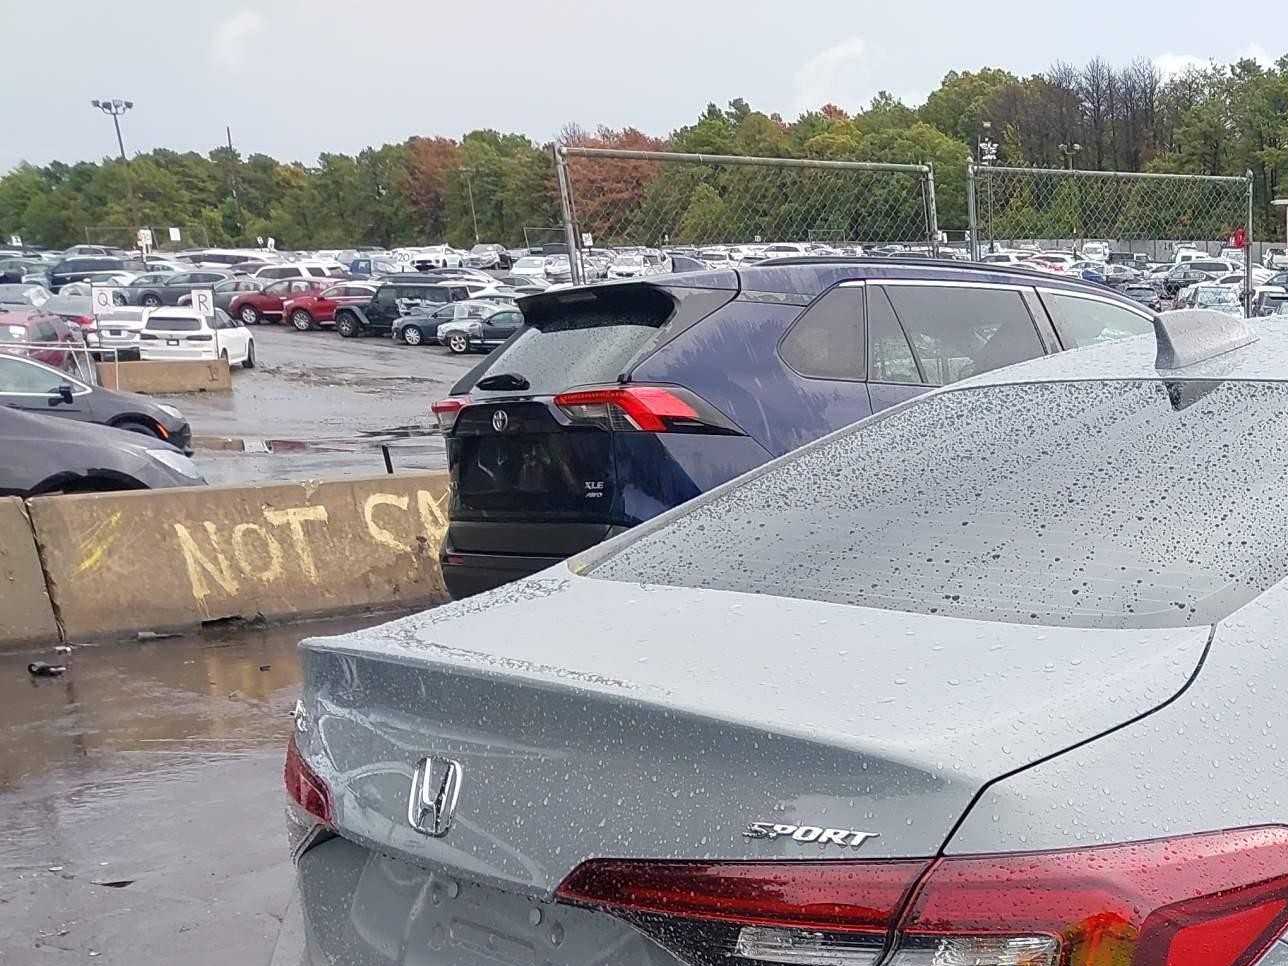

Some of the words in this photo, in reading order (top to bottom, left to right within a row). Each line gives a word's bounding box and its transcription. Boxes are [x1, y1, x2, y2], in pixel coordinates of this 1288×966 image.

[98, 292, 110, 307] Q
[197, 293, 209, 312] R
[584, 481, 604, 490] XLE
[174, 504, 329, 600] NOT
[742, 821, 881, 848] SPORT
